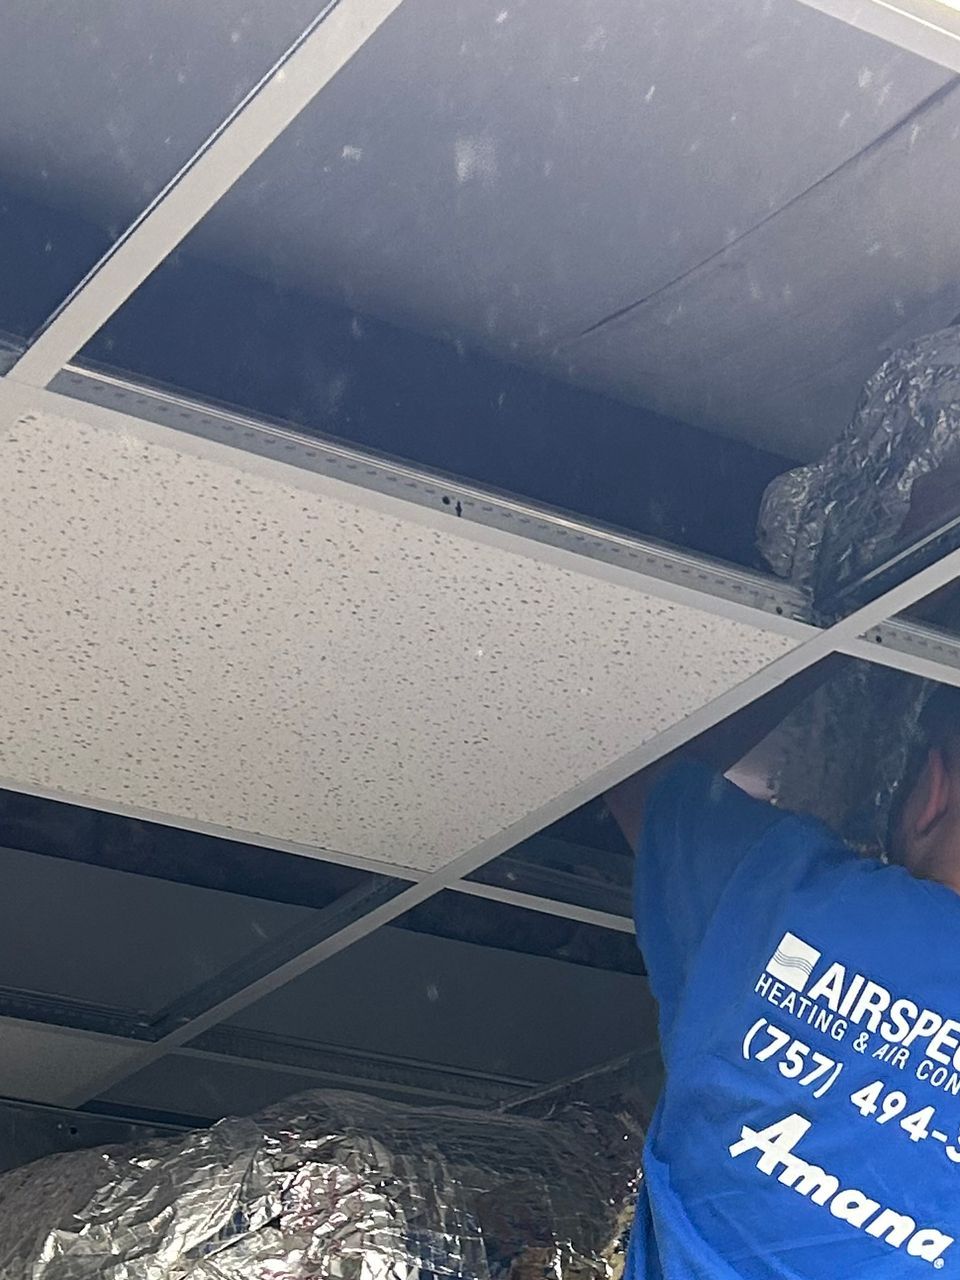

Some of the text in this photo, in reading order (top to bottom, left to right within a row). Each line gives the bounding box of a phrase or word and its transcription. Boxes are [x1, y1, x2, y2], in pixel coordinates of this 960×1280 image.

[742, 1018, 845, 1099] (757)
[754, 973, 848, 1041] HEATING
[852, 1031, 868, 1055] &
[871, 1042, 911, 1070] AIR
[728, 1113, 955, 1266] Amana
